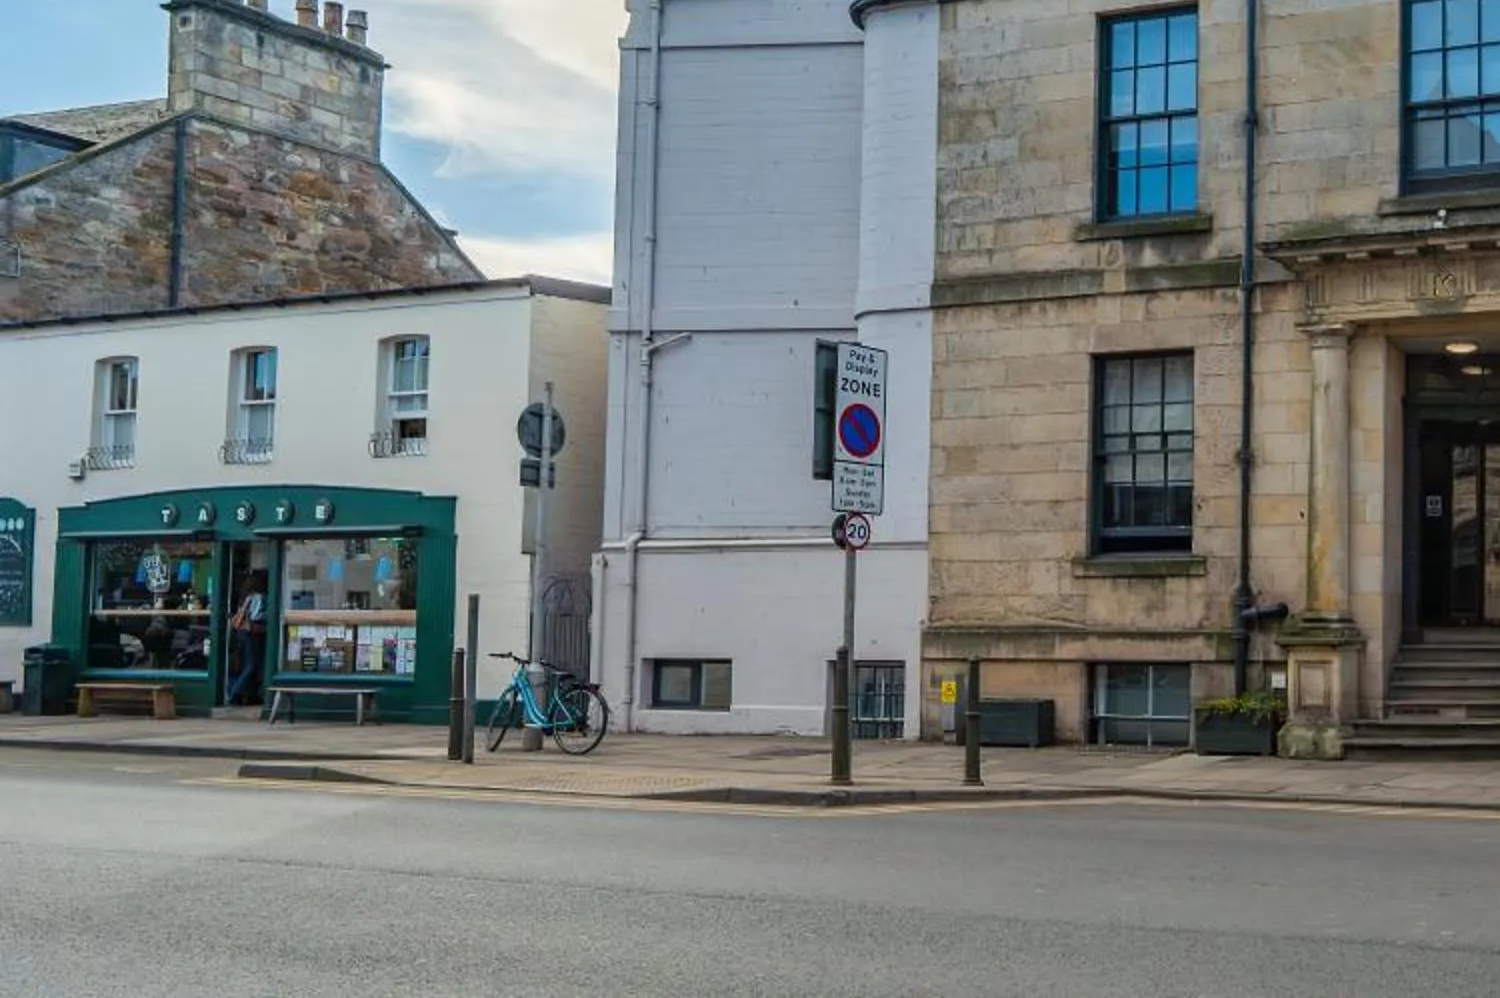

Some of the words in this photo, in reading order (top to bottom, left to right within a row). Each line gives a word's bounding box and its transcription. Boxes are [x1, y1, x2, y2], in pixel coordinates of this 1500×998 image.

[841, 377, 880, 398] ZONE
[161, 505, 325, 523] TASTE
[847, 523, 867, 539] 20
